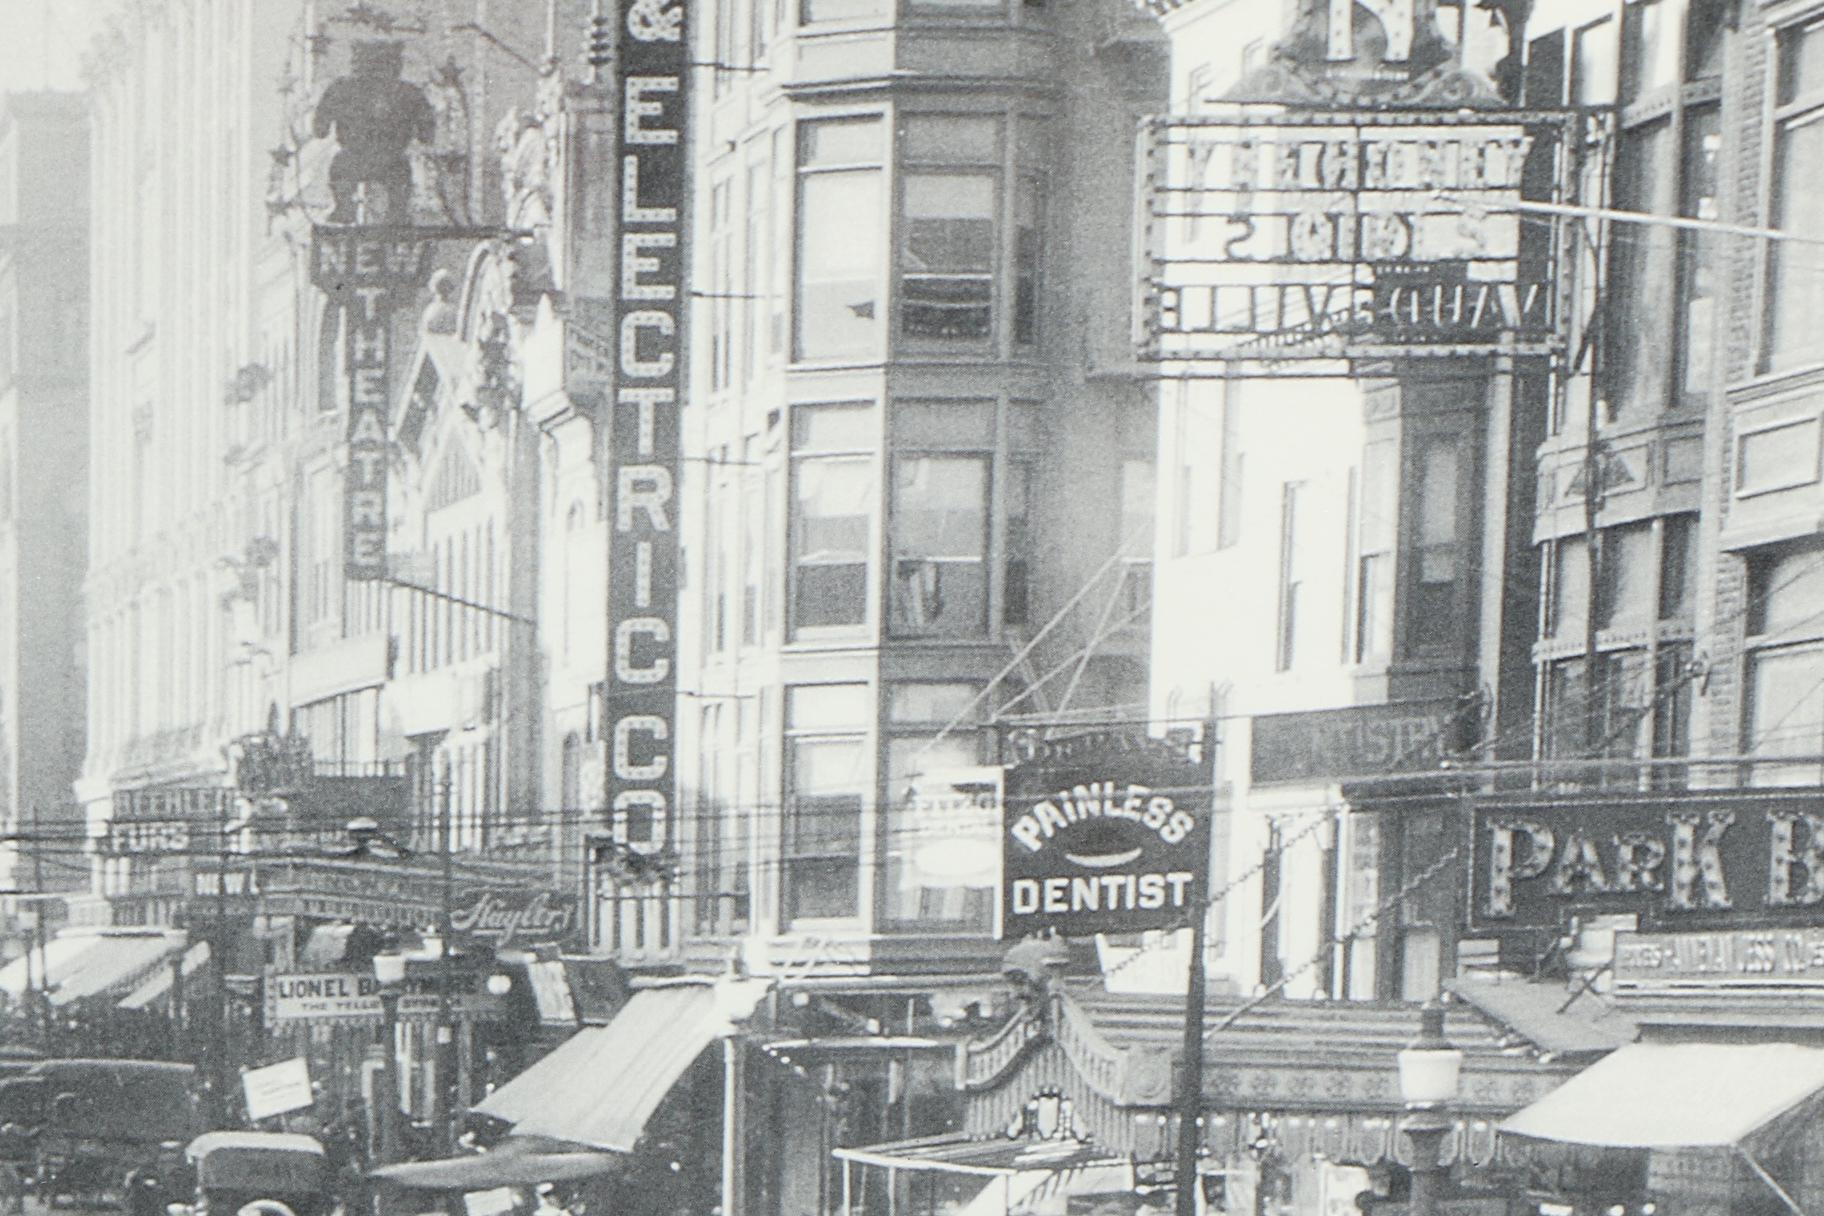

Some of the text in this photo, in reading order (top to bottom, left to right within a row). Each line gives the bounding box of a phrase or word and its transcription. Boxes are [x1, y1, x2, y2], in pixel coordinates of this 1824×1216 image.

[318, 240, 424, 275] NEW
[614, 75, 679, 685] ELECTRIC
[352, 286, 387, 567] THEATRE
[613, 715, 669, 856] CO
[1010, 780, 1195, 852] PAINLESS
[111, 822, 190, 853] FURS
[1482, 808, 1736, 920] PARK
[1012, 871, 1194, 915] DENTIST
[278, 978, 349, 999] LIONEL
